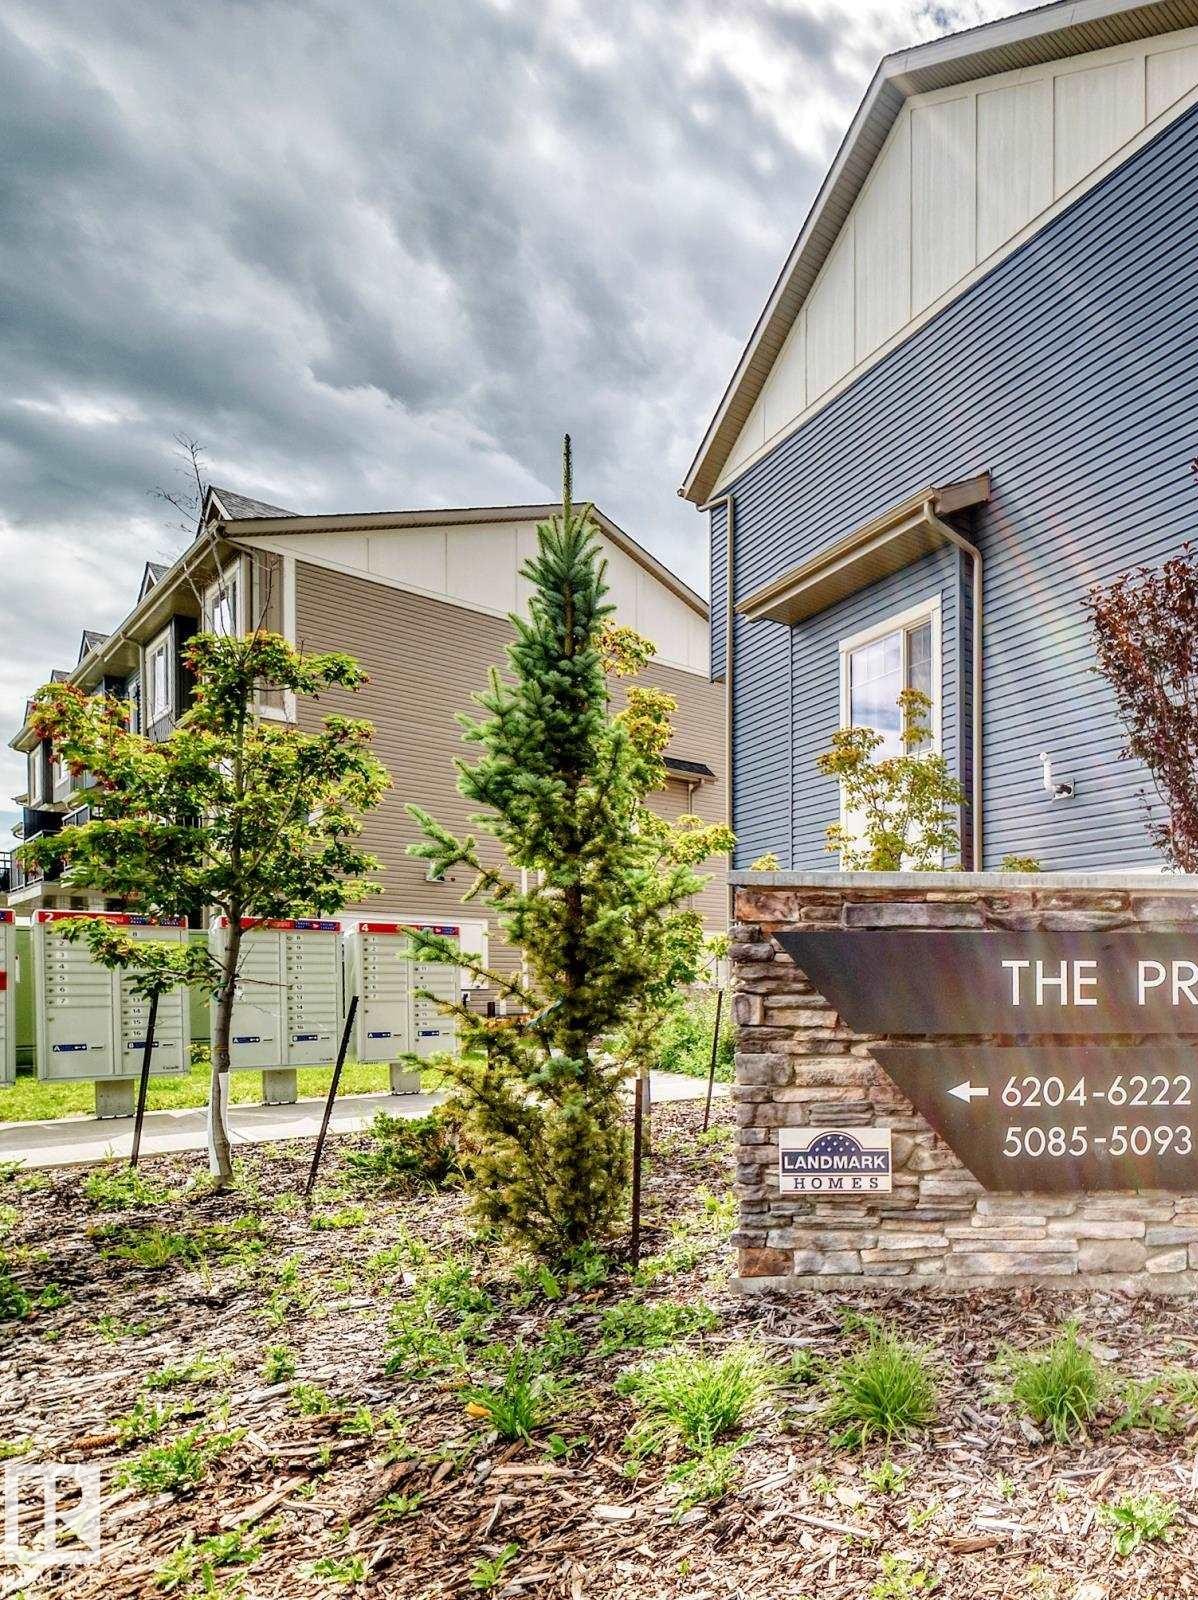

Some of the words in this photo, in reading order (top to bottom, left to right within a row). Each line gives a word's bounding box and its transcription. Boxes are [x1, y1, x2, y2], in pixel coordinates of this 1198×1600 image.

[44, 913, 54, 922] 2
[361, 924, 369, 932] 4
[1002, 960, 1098, 1006] THE
[1001, 1075, 1192, 1107] 6204-6222
[1002, 1125, 1192, 1157] 5085-5093
[784, 1155, 886, 1169] LANDMARK
[793, 1177, 879, 1189] HOMES
